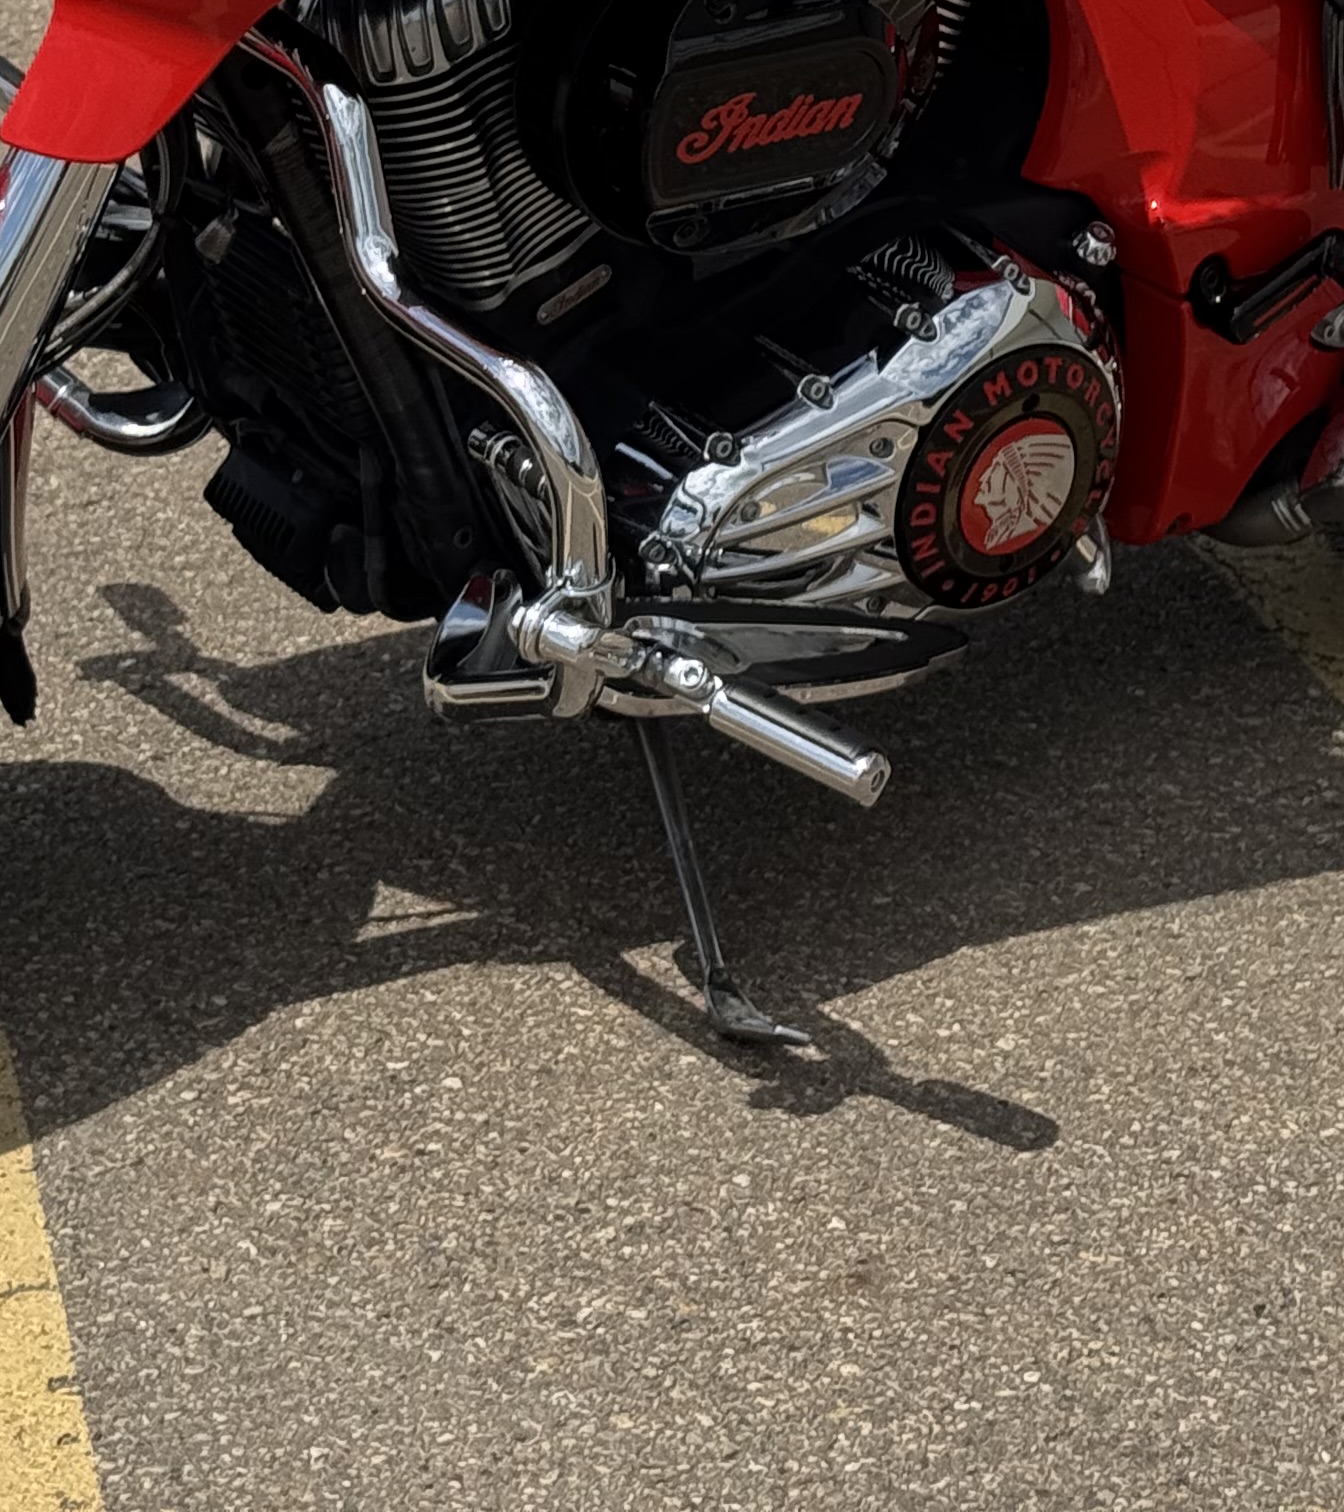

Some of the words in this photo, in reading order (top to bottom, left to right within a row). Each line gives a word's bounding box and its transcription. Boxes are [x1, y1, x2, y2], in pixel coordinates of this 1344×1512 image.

[676, 91, 863, 164] Indian
[909, 409, 975, 579] INDIAN
[960, 565, 1038, 604] 1901
